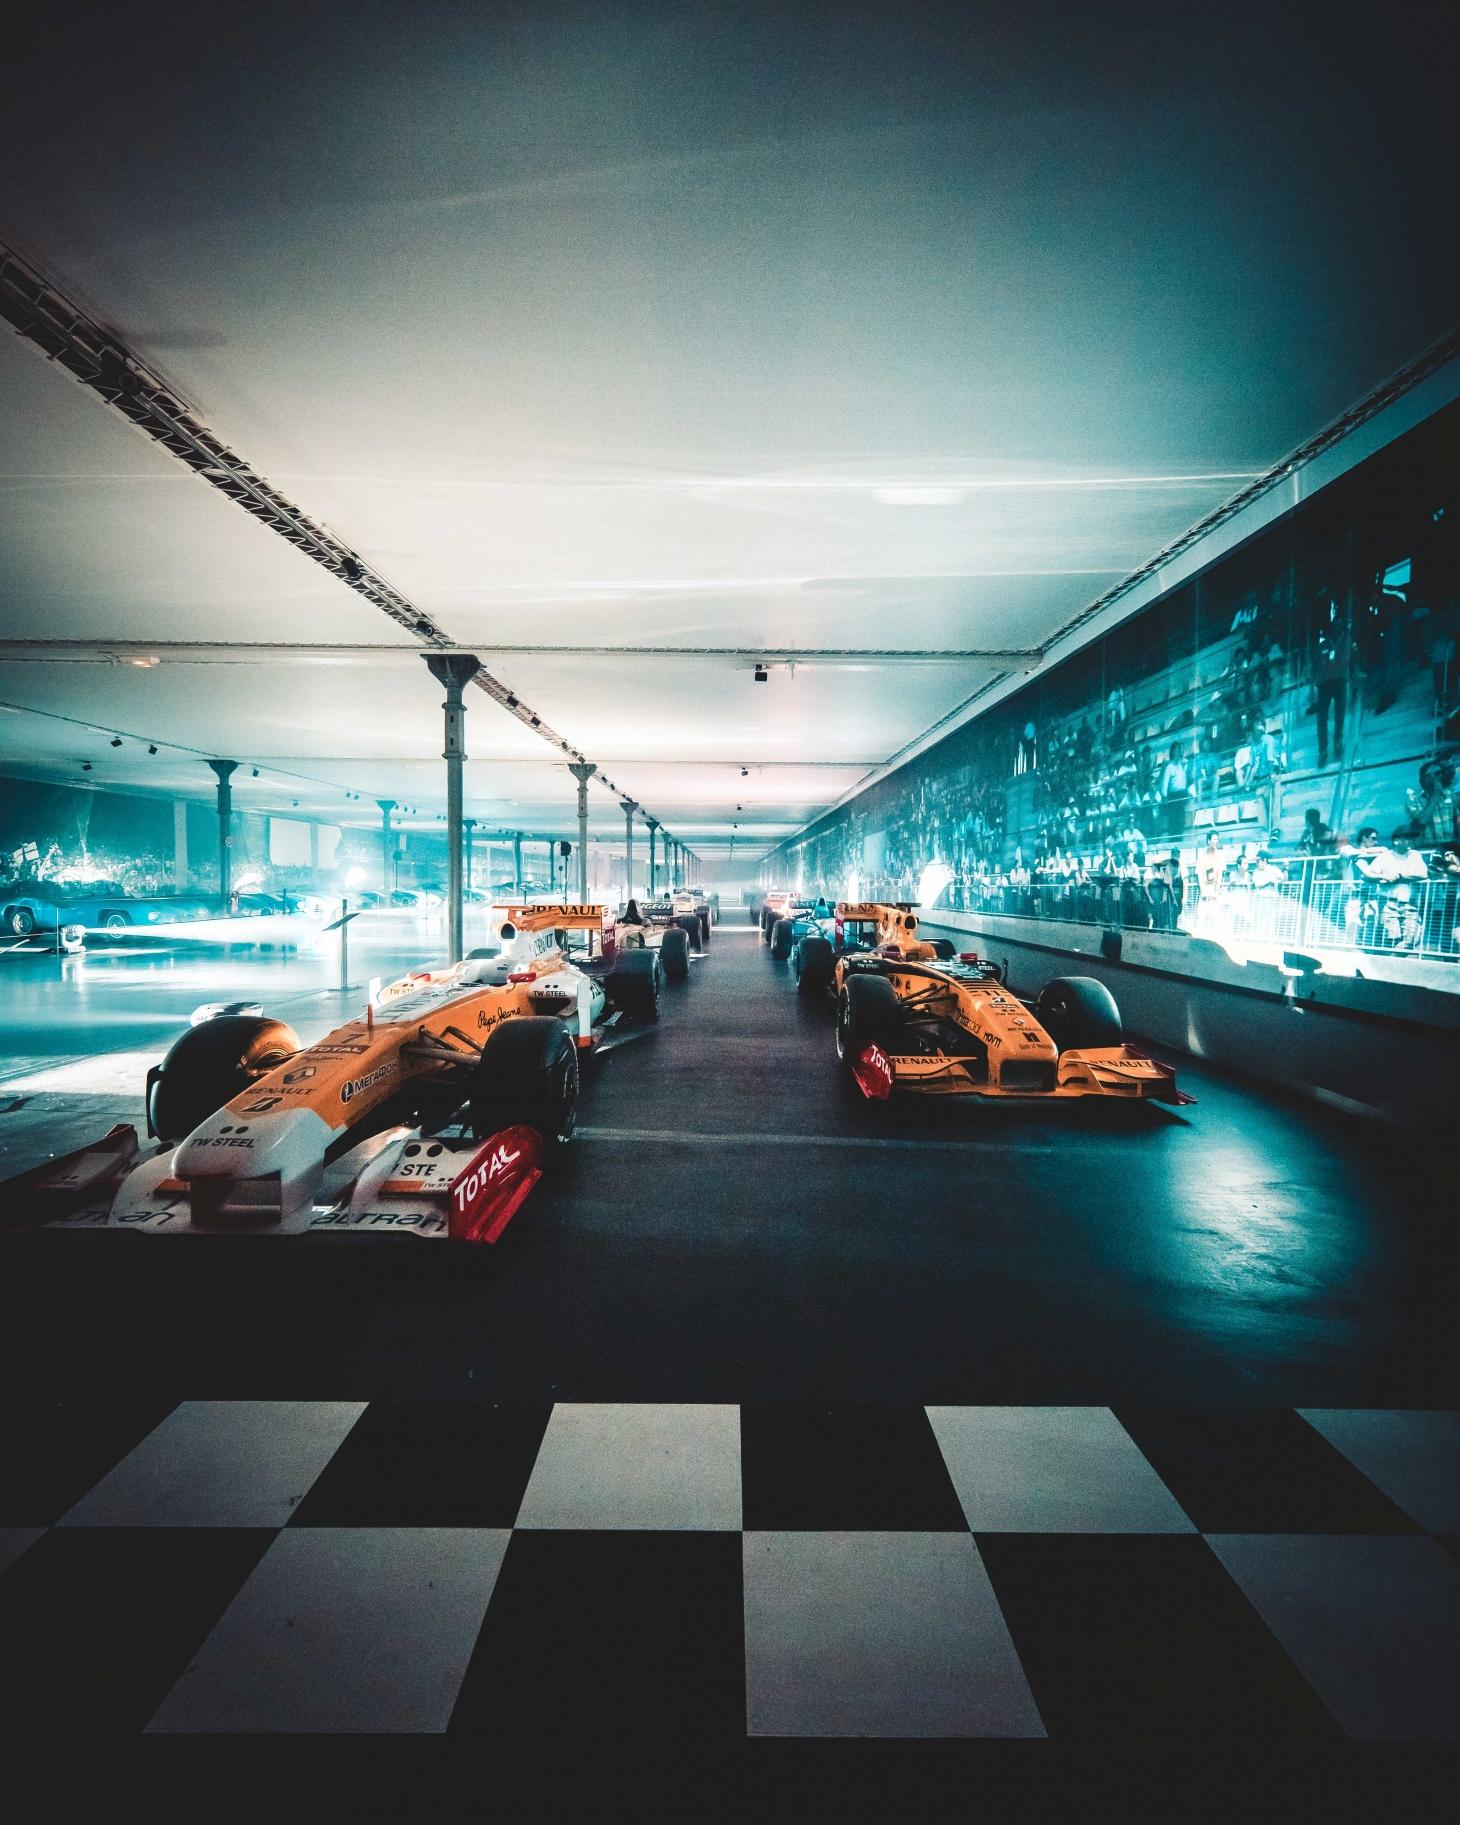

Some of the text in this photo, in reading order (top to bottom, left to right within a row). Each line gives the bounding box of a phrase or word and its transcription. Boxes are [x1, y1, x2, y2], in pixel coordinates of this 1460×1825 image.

[869, 1043, 893, 1085] TOTAL
[893, 1057, 951, 1065] RENAULT
[245, 1087, 316, 1096] RENAULT
[190, 1138, 255, 1148] TW STEEL
[454, 1144, 521, 1212] TOTAL
